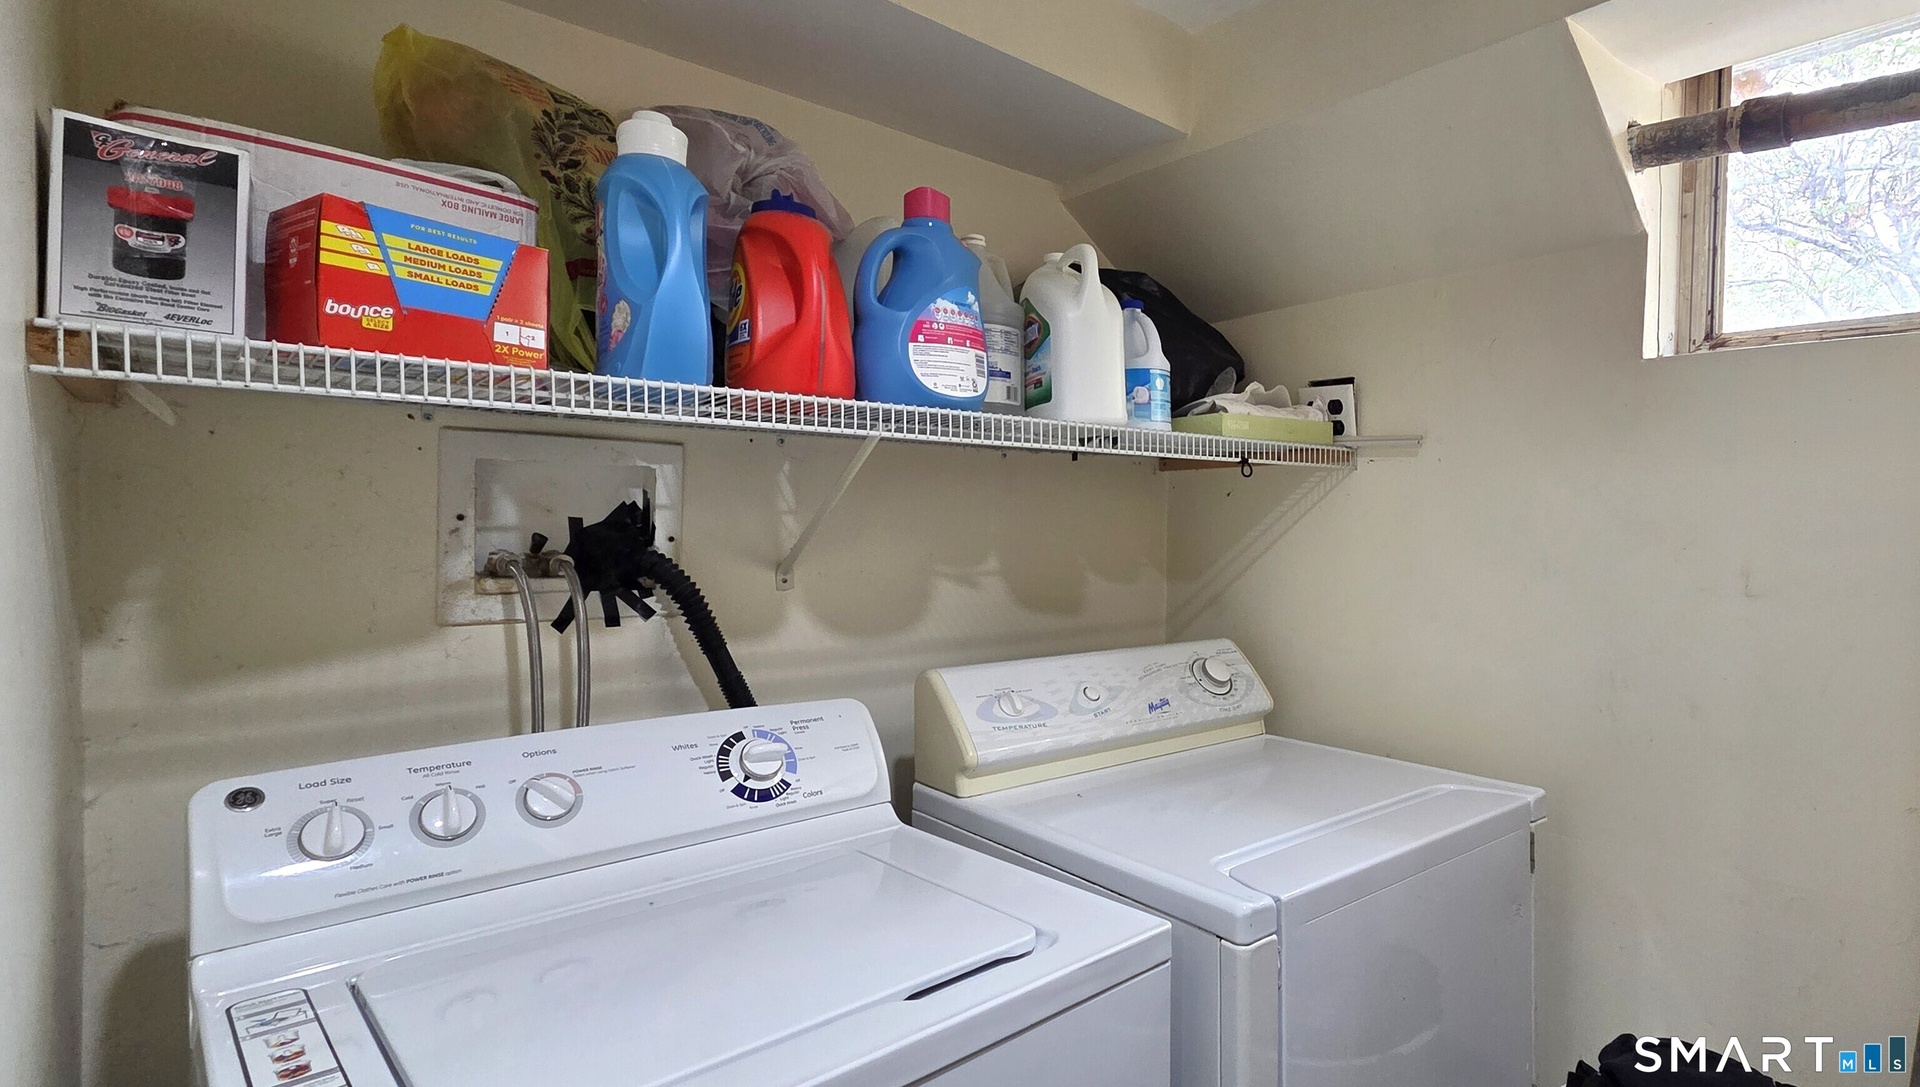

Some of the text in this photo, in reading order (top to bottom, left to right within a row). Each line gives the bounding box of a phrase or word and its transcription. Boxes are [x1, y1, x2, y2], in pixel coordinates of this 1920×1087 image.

[97, 139, 218, 166] General
[411, 185, 465, 202] INTERNATIONAL
[441, 199, 524, 226] LARGE MAILING BOX
[410, 223, 477, 245] FOR BEST RESULTS
[407, 242, 480, 265] LARGE LOADS
[403, 255, 483, 279] MEDIUM LOADS
[406, 270, 480, 292] SMALL LOADS
[325, 298, 394, 319] bounce
[494, 344, 545, 360] 2X Power
[1093, 706, 1112, 718] START
[789, 716, 825, 726] Permanent
[792, 724, 810, 732] Press
[992, 722, 1048, 732] TEMPERATURE
[521, 748, 557, 759] Options
[671, 743, 698, 751] Whites
[407, 760, 472, 775] Temperature
[298, 776, 352, 790] Load Size
[802, 789, 823, 799] Colors
[264, 831, 283, 839] Large
[350, 862, 374, 871] Medium
[357, 885, 379, 895] Clothes
[379, 882, 393, 890] Care
[406, 875, 428, 884] POWER
[428, 871, 445, 880] RINSE
[444, 868, 463, 877] option
